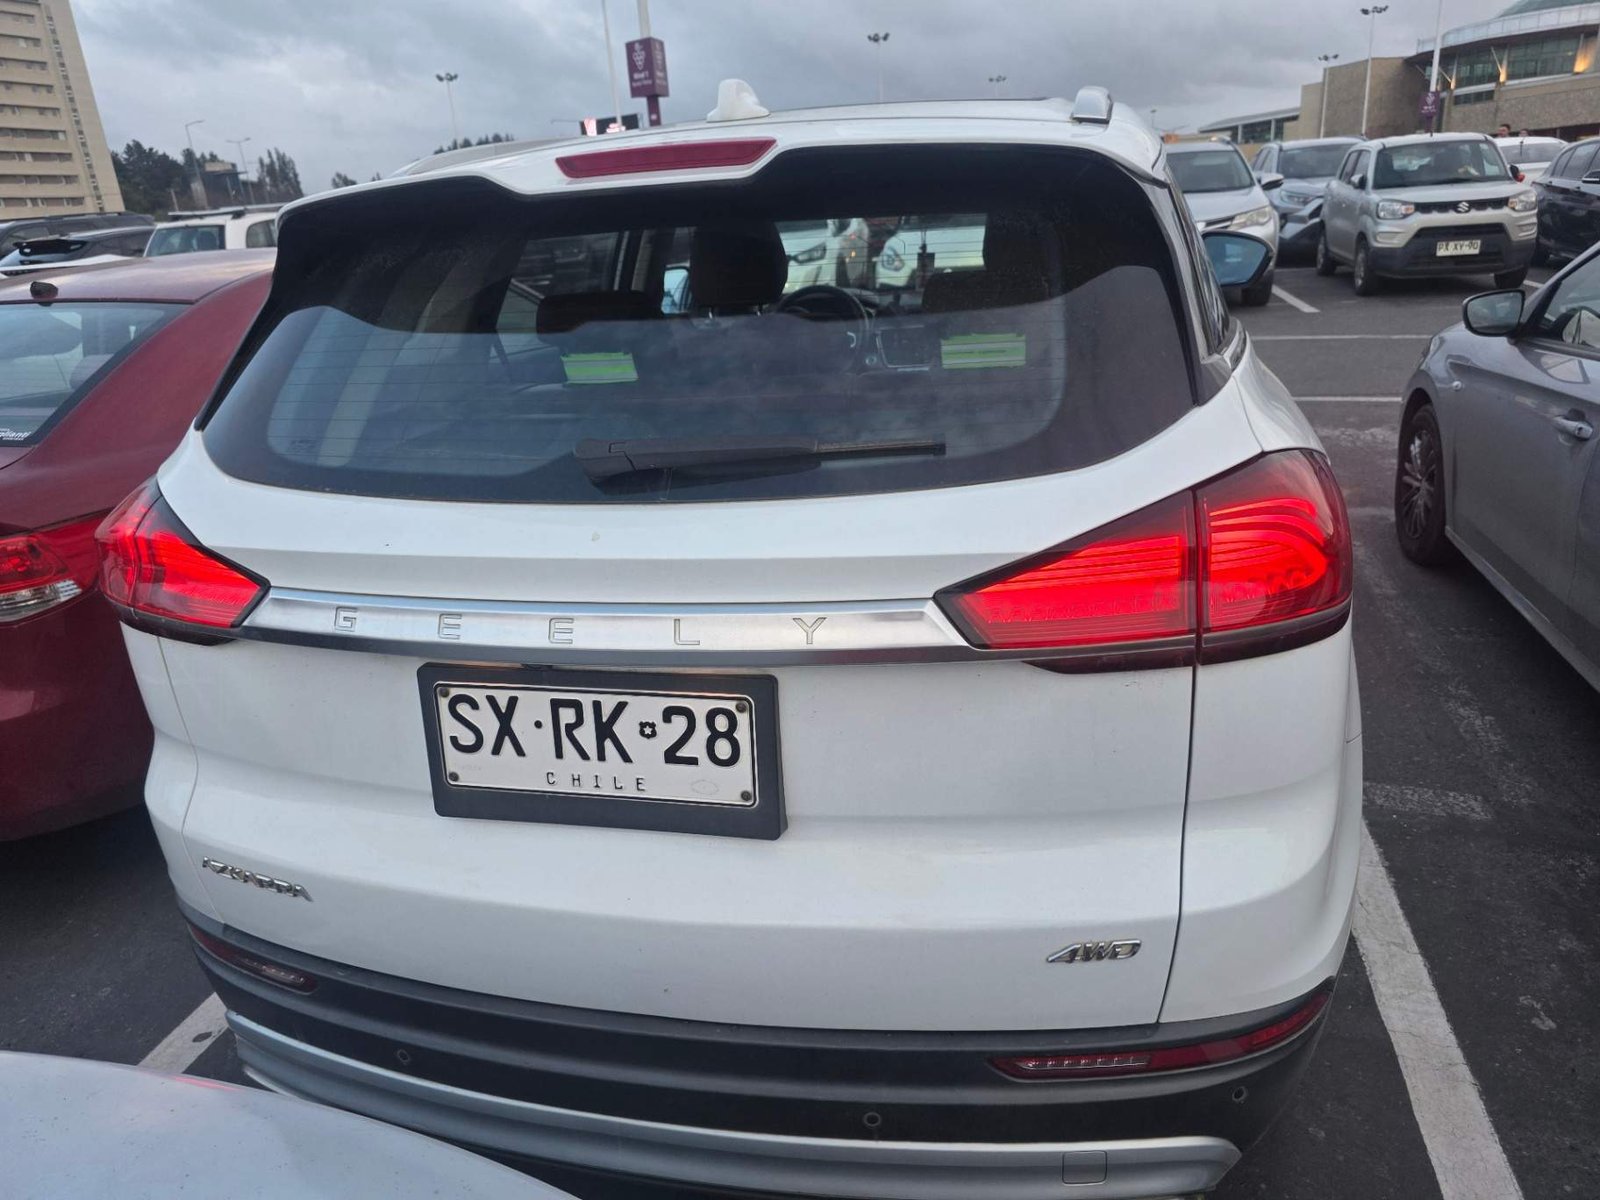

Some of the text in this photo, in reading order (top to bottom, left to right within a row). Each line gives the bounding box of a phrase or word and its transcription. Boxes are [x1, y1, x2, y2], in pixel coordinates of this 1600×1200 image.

[334, 605, 827, 646] GEELY
[546, 771, 646, 791] CHILE
[1046, 939, 1142, 963] 4WD
